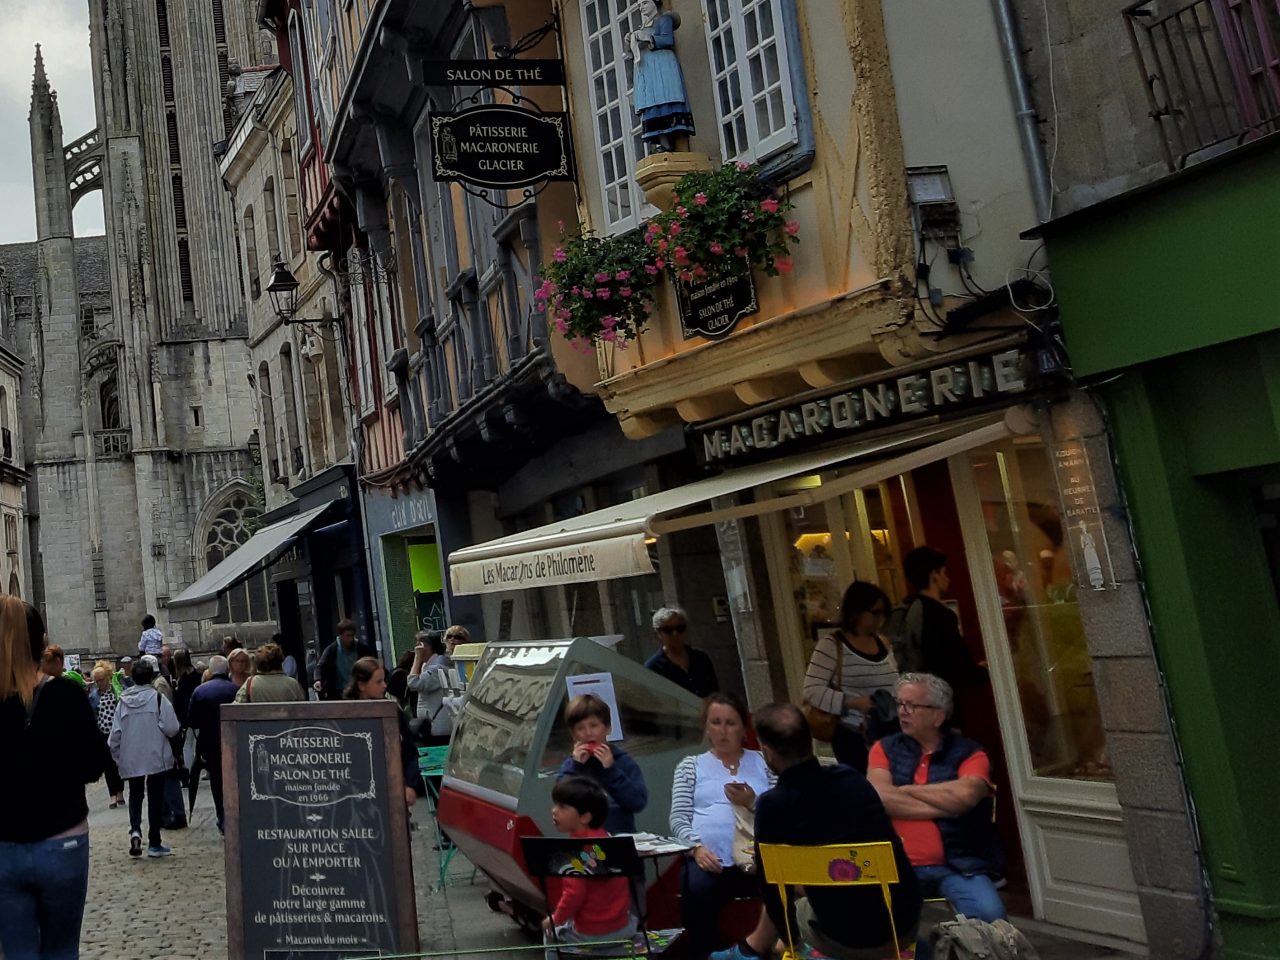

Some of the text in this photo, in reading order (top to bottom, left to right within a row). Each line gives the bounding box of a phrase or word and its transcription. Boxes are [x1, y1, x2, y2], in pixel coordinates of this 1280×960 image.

[446, 66, 543, 81] SALON DE THÉ
[469, 123, 529, 138] PÂTISSERIE
[460, 142, 540, 153] MACARONERIE
[478, 159, 525, 171] GLACIER
[703, 349, 1025, 462] MACARONERIE
[482, 565, 495, 585] Les
[535, 554, 546, 578] de
[546, 549, 596, 577] Philomène
[279, 735, 341, 749] PÂTISSERIE
[270, 752, 352, 765] MACARONERIE
[273, 767, 351, 780] SALON DE THÉ
[284, 782, 341, 793] maison fondée
[310, 794, 329, 803] 1966
[257, 828, 339, 840] RESTAURATION
[287, 842, 345, 854] SUR PLACE
[273, 857, 290, 868] OU
[303, 856, 361, 868] EMPORTER
[291, 884, 345, 896] Découvrez
[273, 898, 366, 911] notre large gamme
[254, 911, 387, 925] de pâtisseries & macarons.
[285, 933, 358, 945] Macaron du mois
